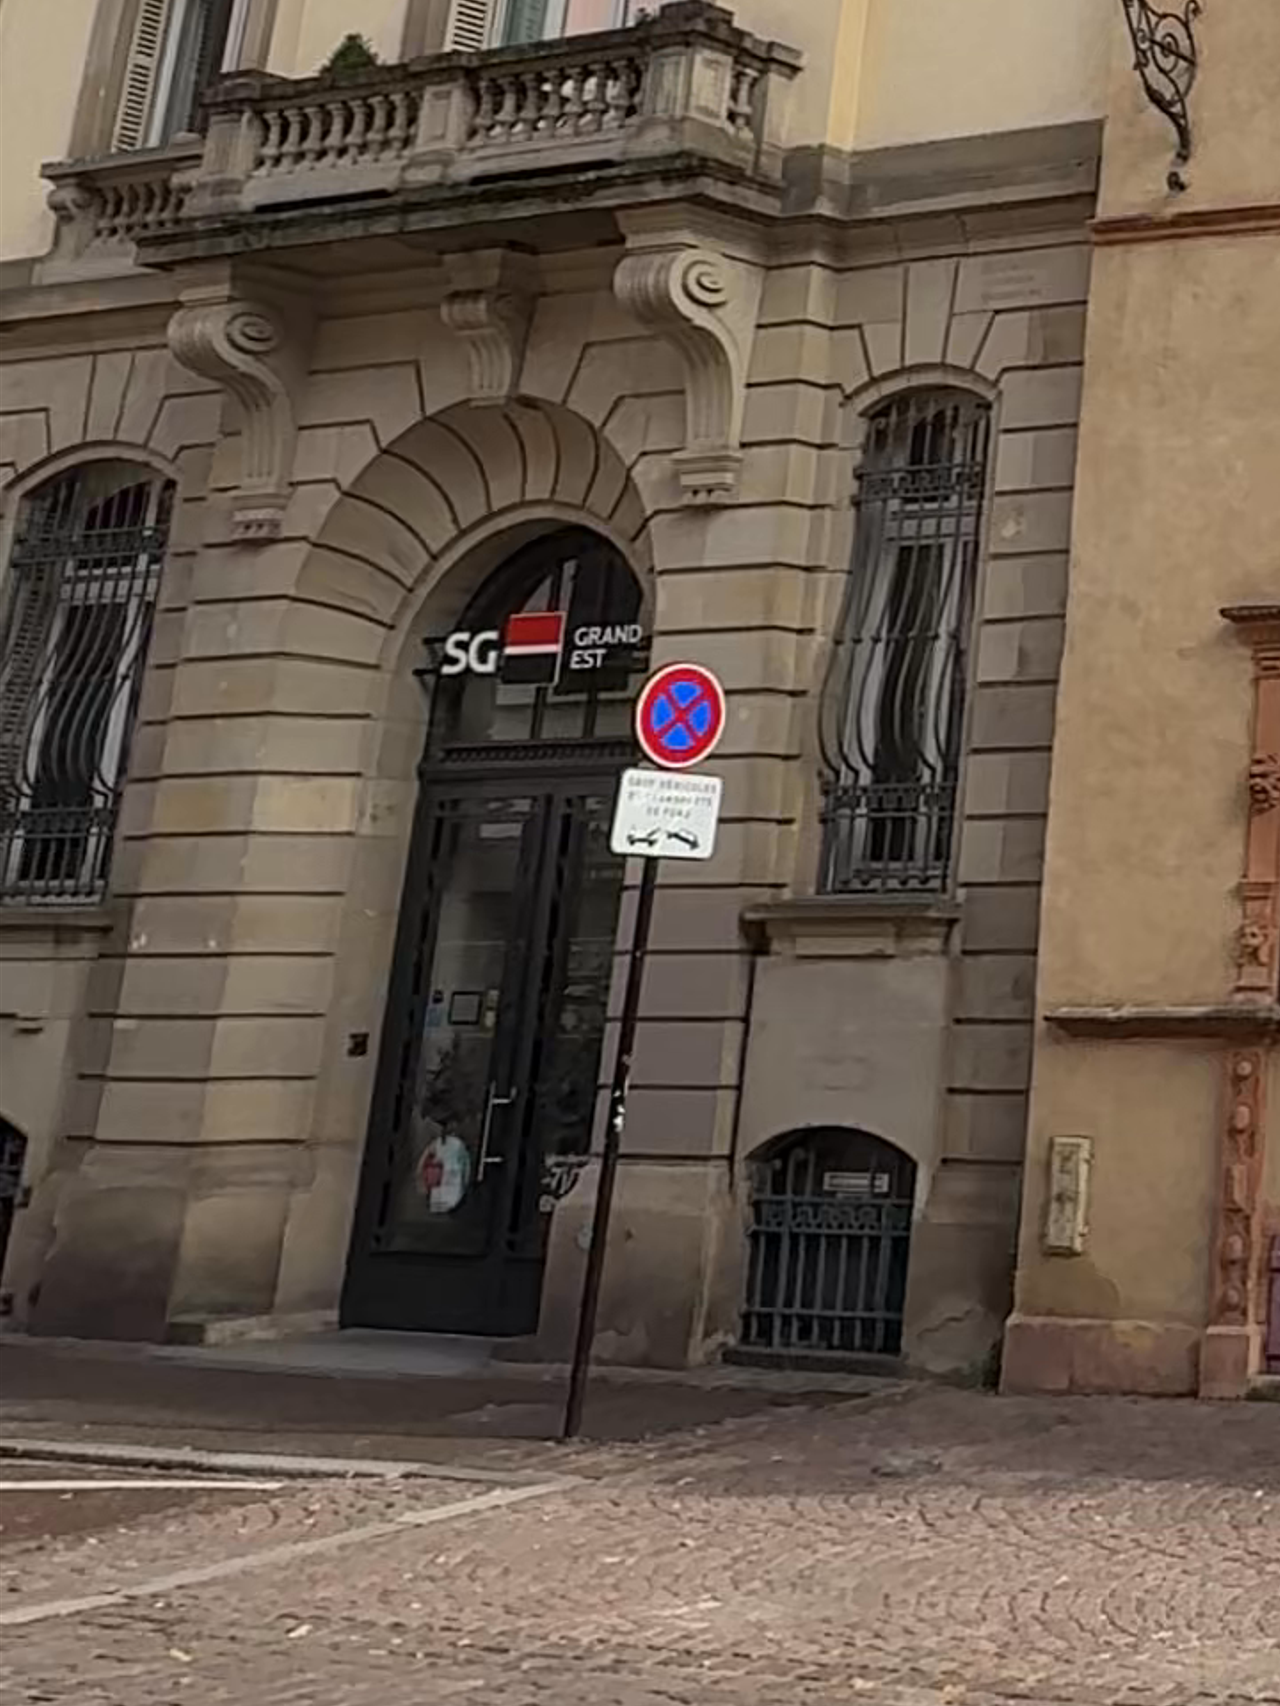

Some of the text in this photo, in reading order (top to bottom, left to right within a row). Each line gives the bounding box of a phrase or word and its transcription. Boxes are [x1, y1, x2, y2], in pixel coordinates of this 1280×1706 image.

[574, 625, 642, 646] GRAND
[441, 631, 498, 674] SG
[570, 649, 606, 669] EST
